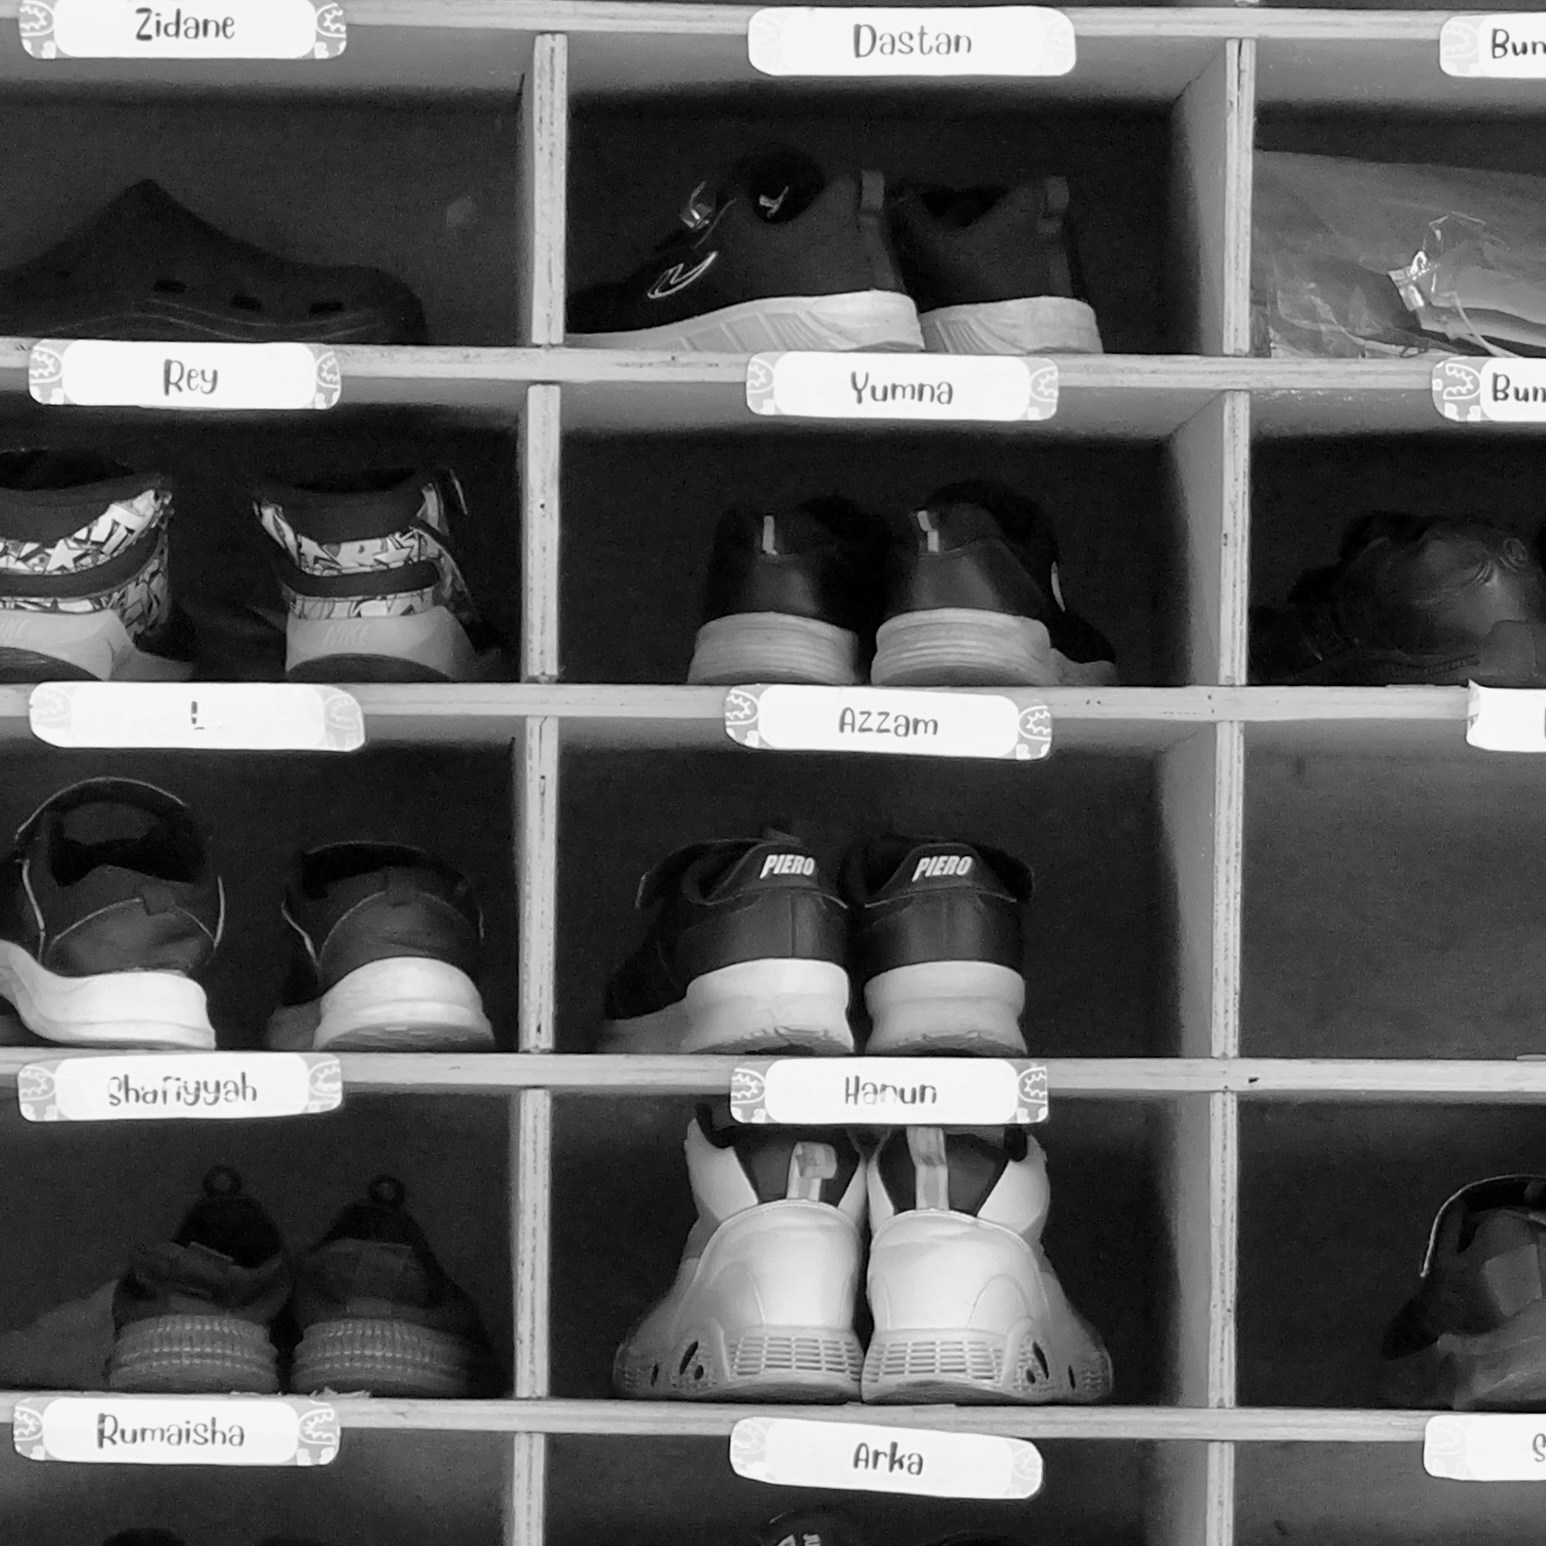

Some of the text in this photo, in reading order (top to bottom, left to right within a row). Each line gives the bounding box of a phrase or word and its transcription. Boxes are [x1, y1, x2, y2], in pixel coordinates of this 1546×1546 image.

[136, 8, 234, 41] Zidane
[854, 24, 972, 58] Dastan
[164, 359, 218, 396] Rey
[851, 372, 953, 404] Yumna
[839, 707, 938, 737] Azzam
[760, 854, 816, 879] PIERO
[912, 855, 974, 883] PIERO
[97, 1413, 244, 1449] Rumaisha
[853, 1442, 923, 1475] Arka
